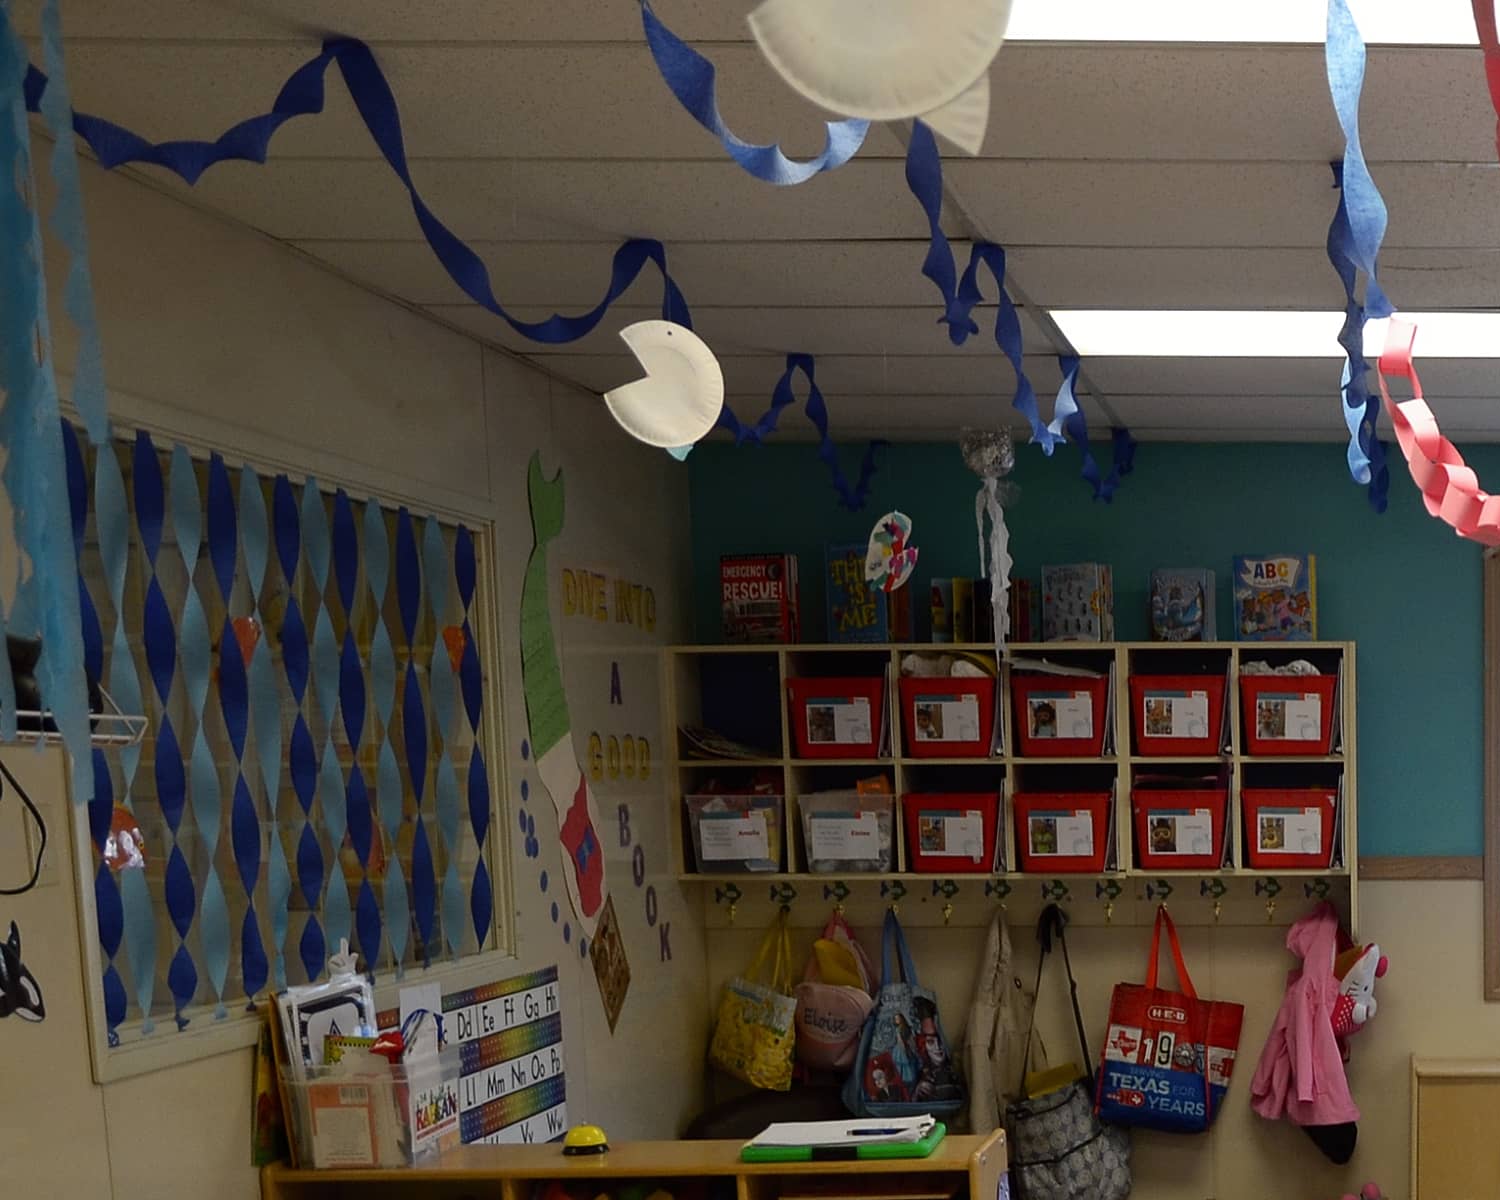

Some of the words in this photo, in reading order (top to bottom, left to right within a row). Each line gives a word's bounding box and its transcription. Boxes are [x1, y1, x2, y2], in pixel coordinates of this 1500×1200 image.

[722, 564, 767, 579] EMERGENCY
[1253, 560, 1290, 581] ABC
[561, 568, 608, 622] DIVE
[613, 578, 657, 634] INTO
[722, 580, 783, 601] RESCUE!
[610, 661, 623, 705] A
[587, 730, 651, 782] GOOD
[457, 1011, 472, 1039] Dd
[482, 1004, 495, 1032] Ee
[503, 1000, 515, 1026] Ff
[523, 993, 540, 1020] Gg
[545, 987, 557, 1013] Hh
[487, 1073, 506, 1100] Mm
[511, 1063, 528, 1088] Nn
[531, 1055, 546, 1081] Oo
[551, 1048, 561, 1074] Pp
[1108, 1072, 1171, 1095] TEXAS
[1172, 1086, 1198, 1097] FOR
[1147, 1095, 1206, 1117] YEARS
[546, 1112, 563, 1135] Ww
